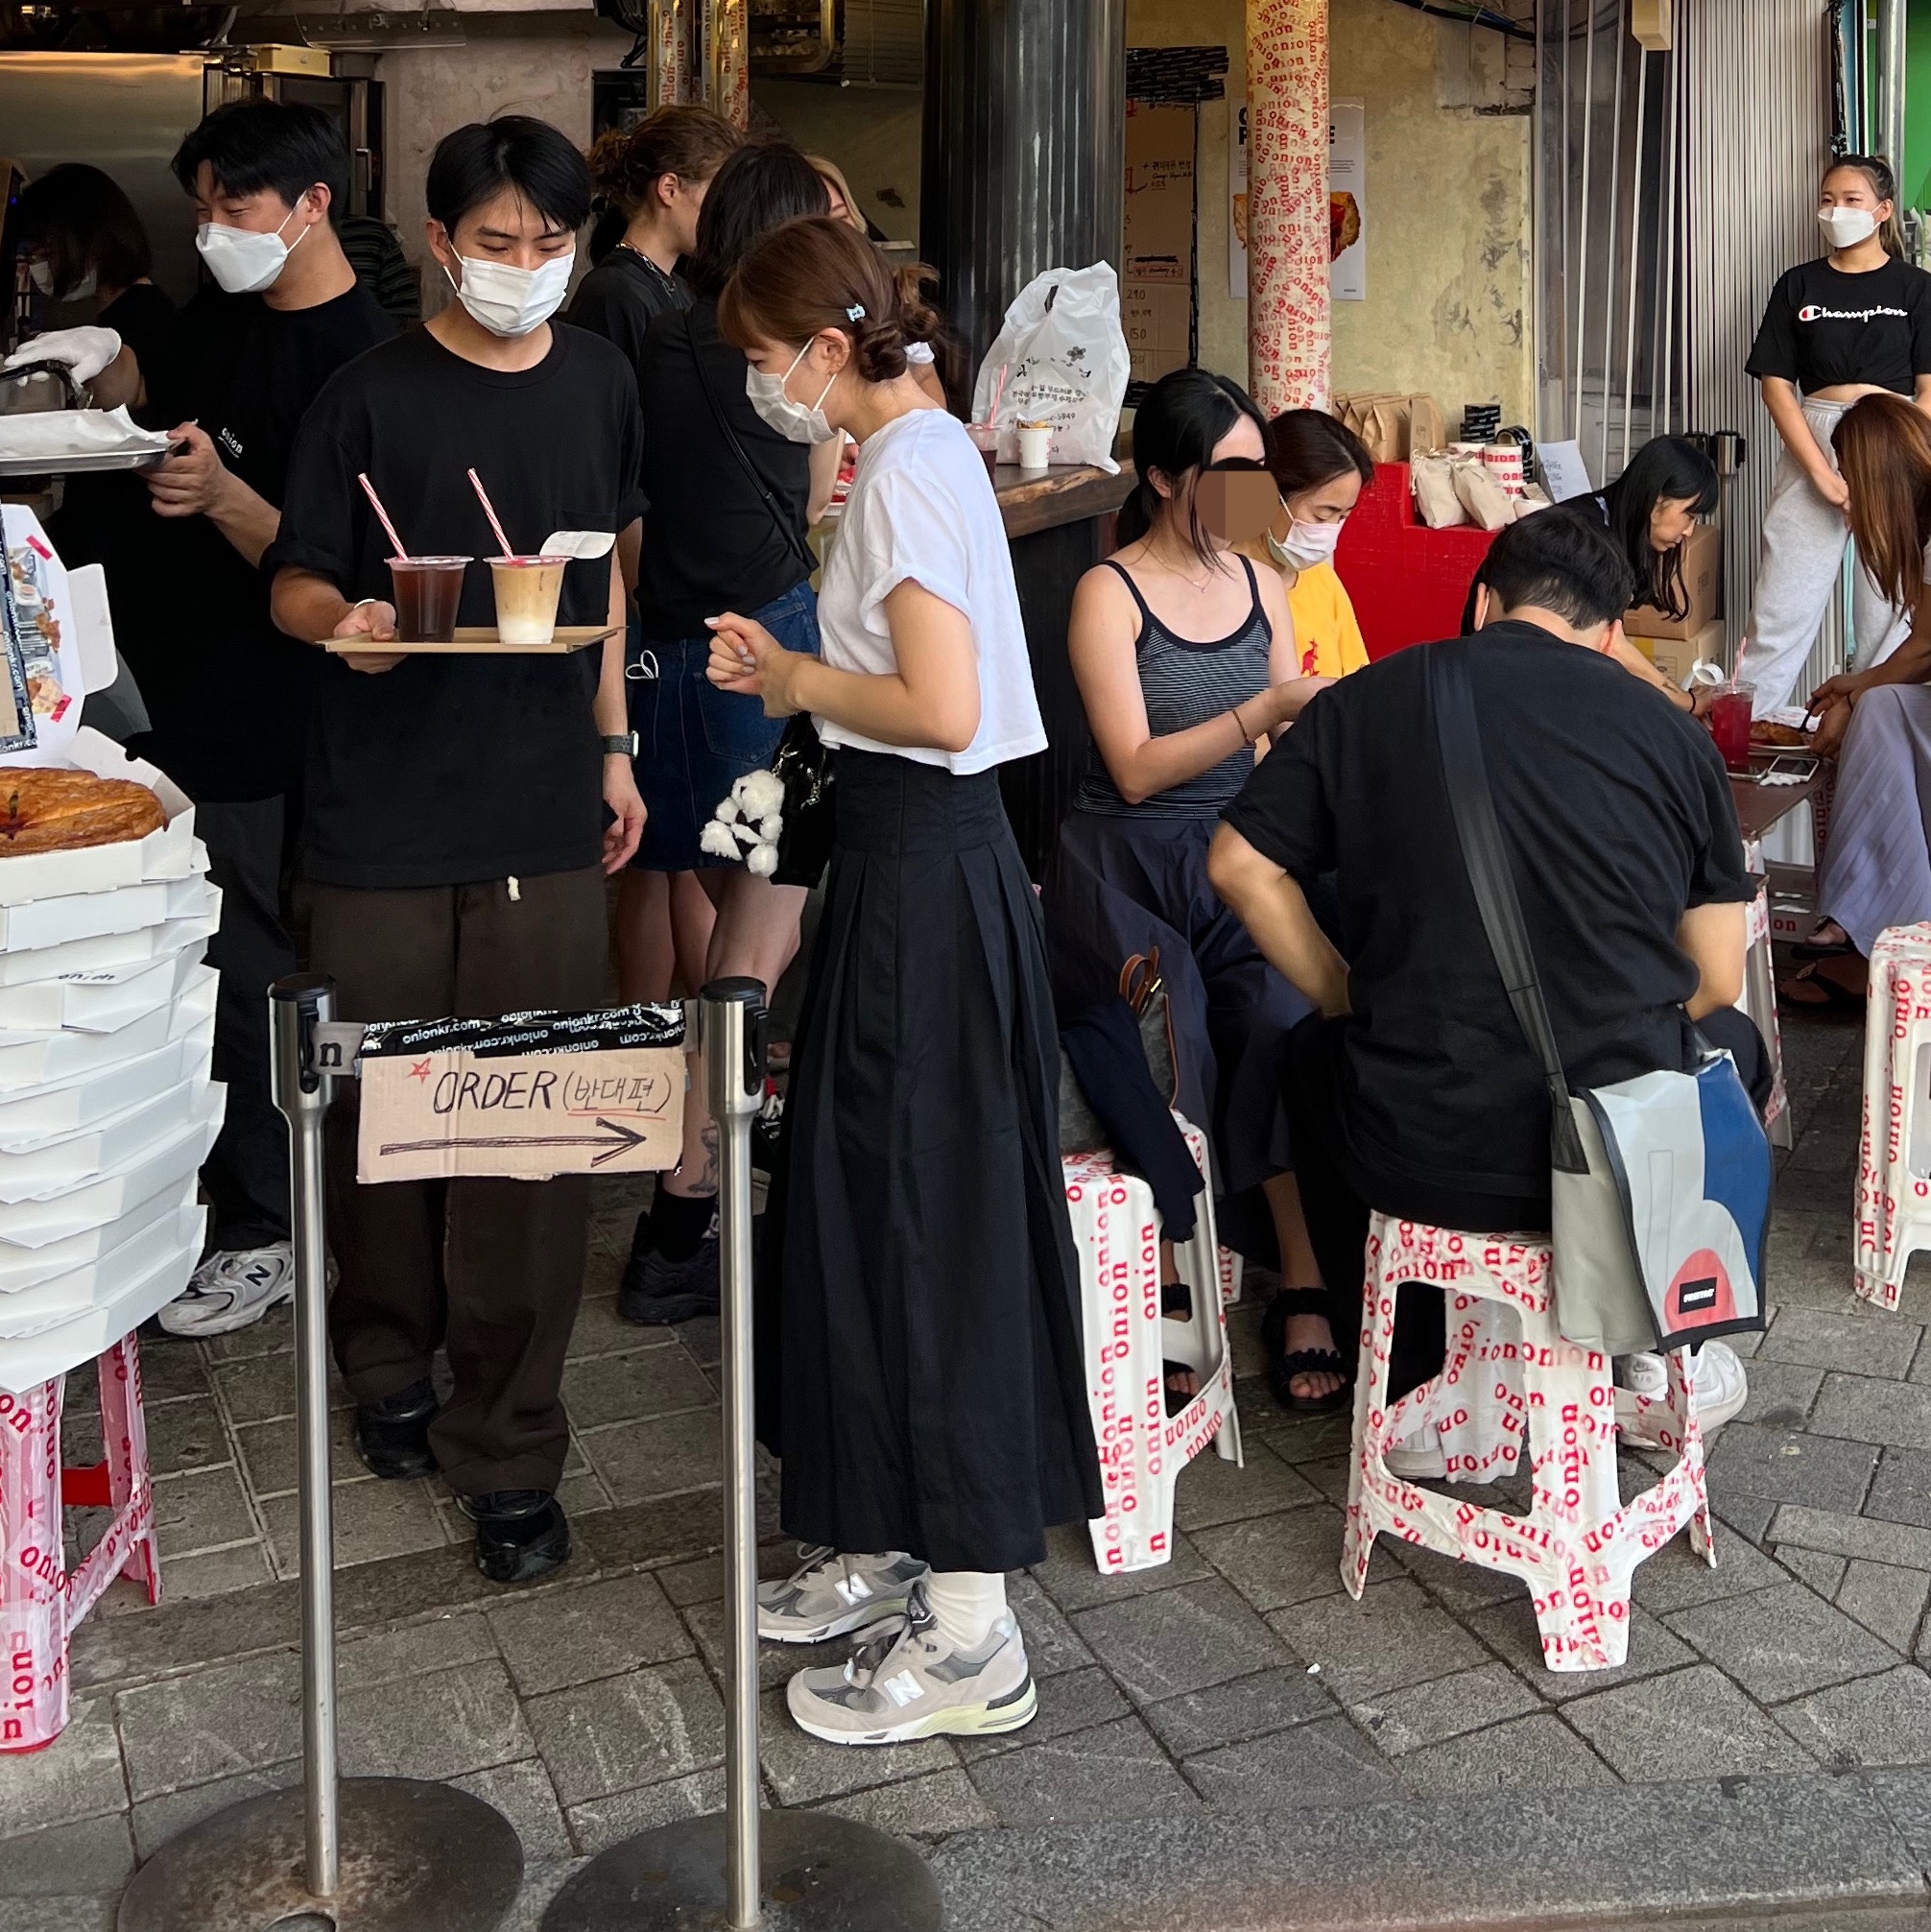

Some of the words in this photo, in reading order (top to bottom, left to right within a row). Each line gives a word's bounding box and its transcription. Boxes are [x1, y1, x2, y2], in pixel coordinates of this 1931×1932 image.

[1272, 152, 1312, 166] onion
[1799, 305, 1908, 322] Champion
[402, 1019, 481, 1044] onionkr.com
[552, 1008, 630, 1031] onionkr.com
[433, 1069, 558, 1114] ORDER
[1090, 1190, 1109, 1288] onion
[1134, 1222, 1156, 1321] onion
[1385, 1259, 1457, 1283] onion
[1109, 1259, 1130, 1359] onion
[1093, 1343, 1117, 1443] onion
[1140, 1374, 1162, 1476] onion
[1561, 1404, 1581, 1508] onion
[19, 1546, 73, 1603] onion
